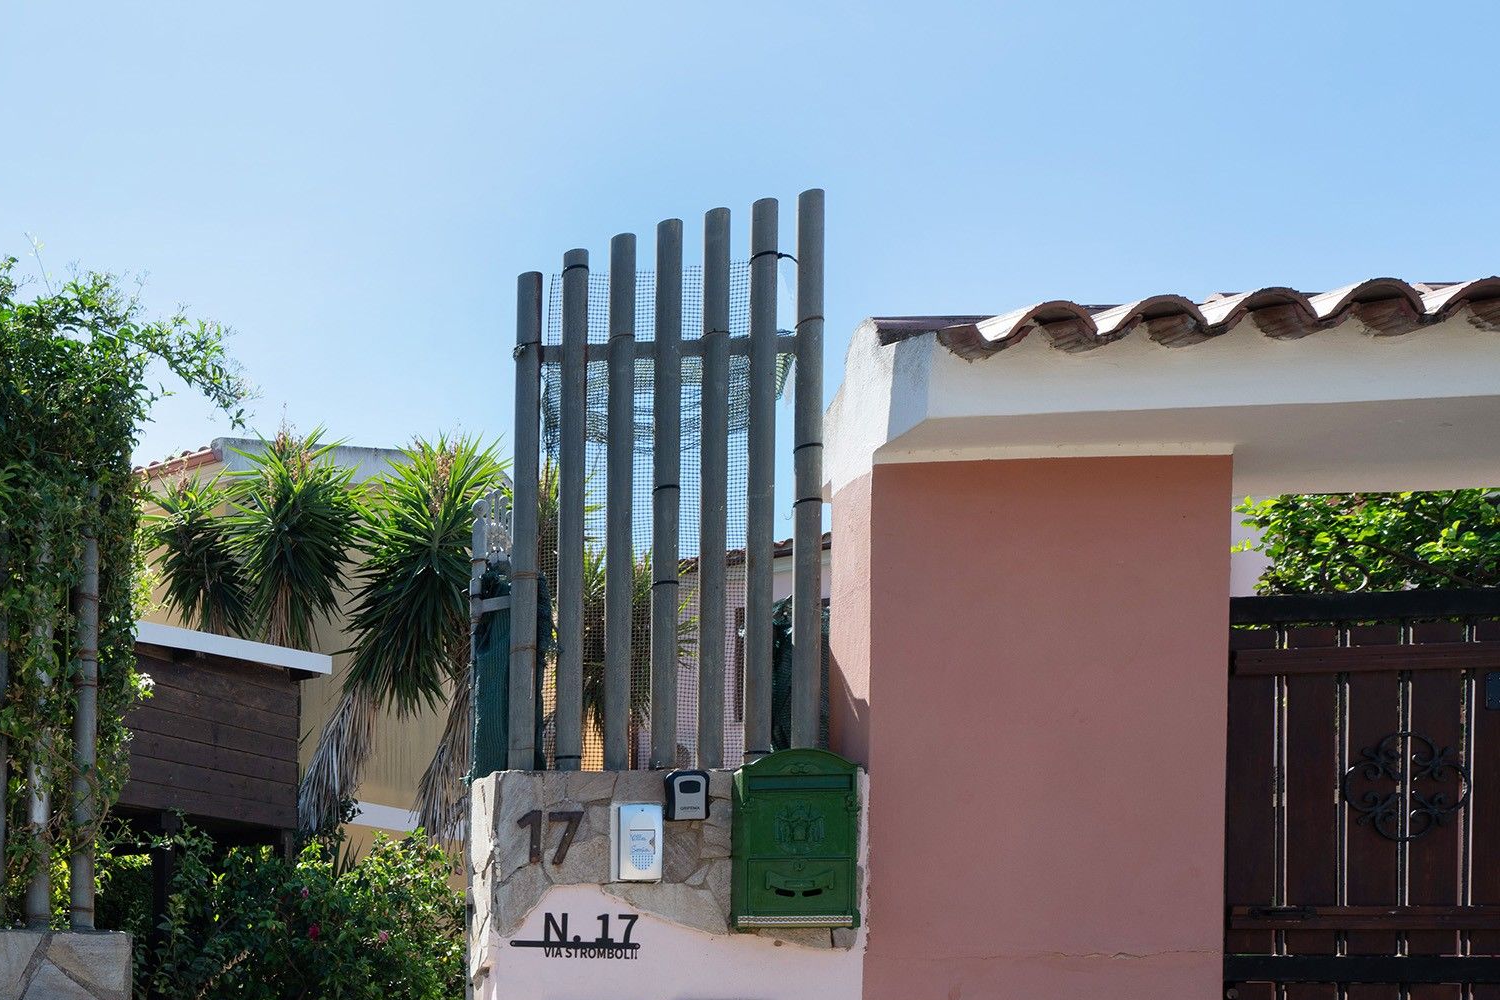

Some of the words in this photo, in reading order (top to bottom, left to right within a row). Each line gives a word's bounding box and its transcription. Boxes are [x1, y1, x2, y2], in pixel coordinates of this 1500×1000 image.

[517, 809, 585, 865] 17
[544, 912, 581, 945] N.
[595, 913, 639, 947] 17
[544, 947, 562, 957] VIA
